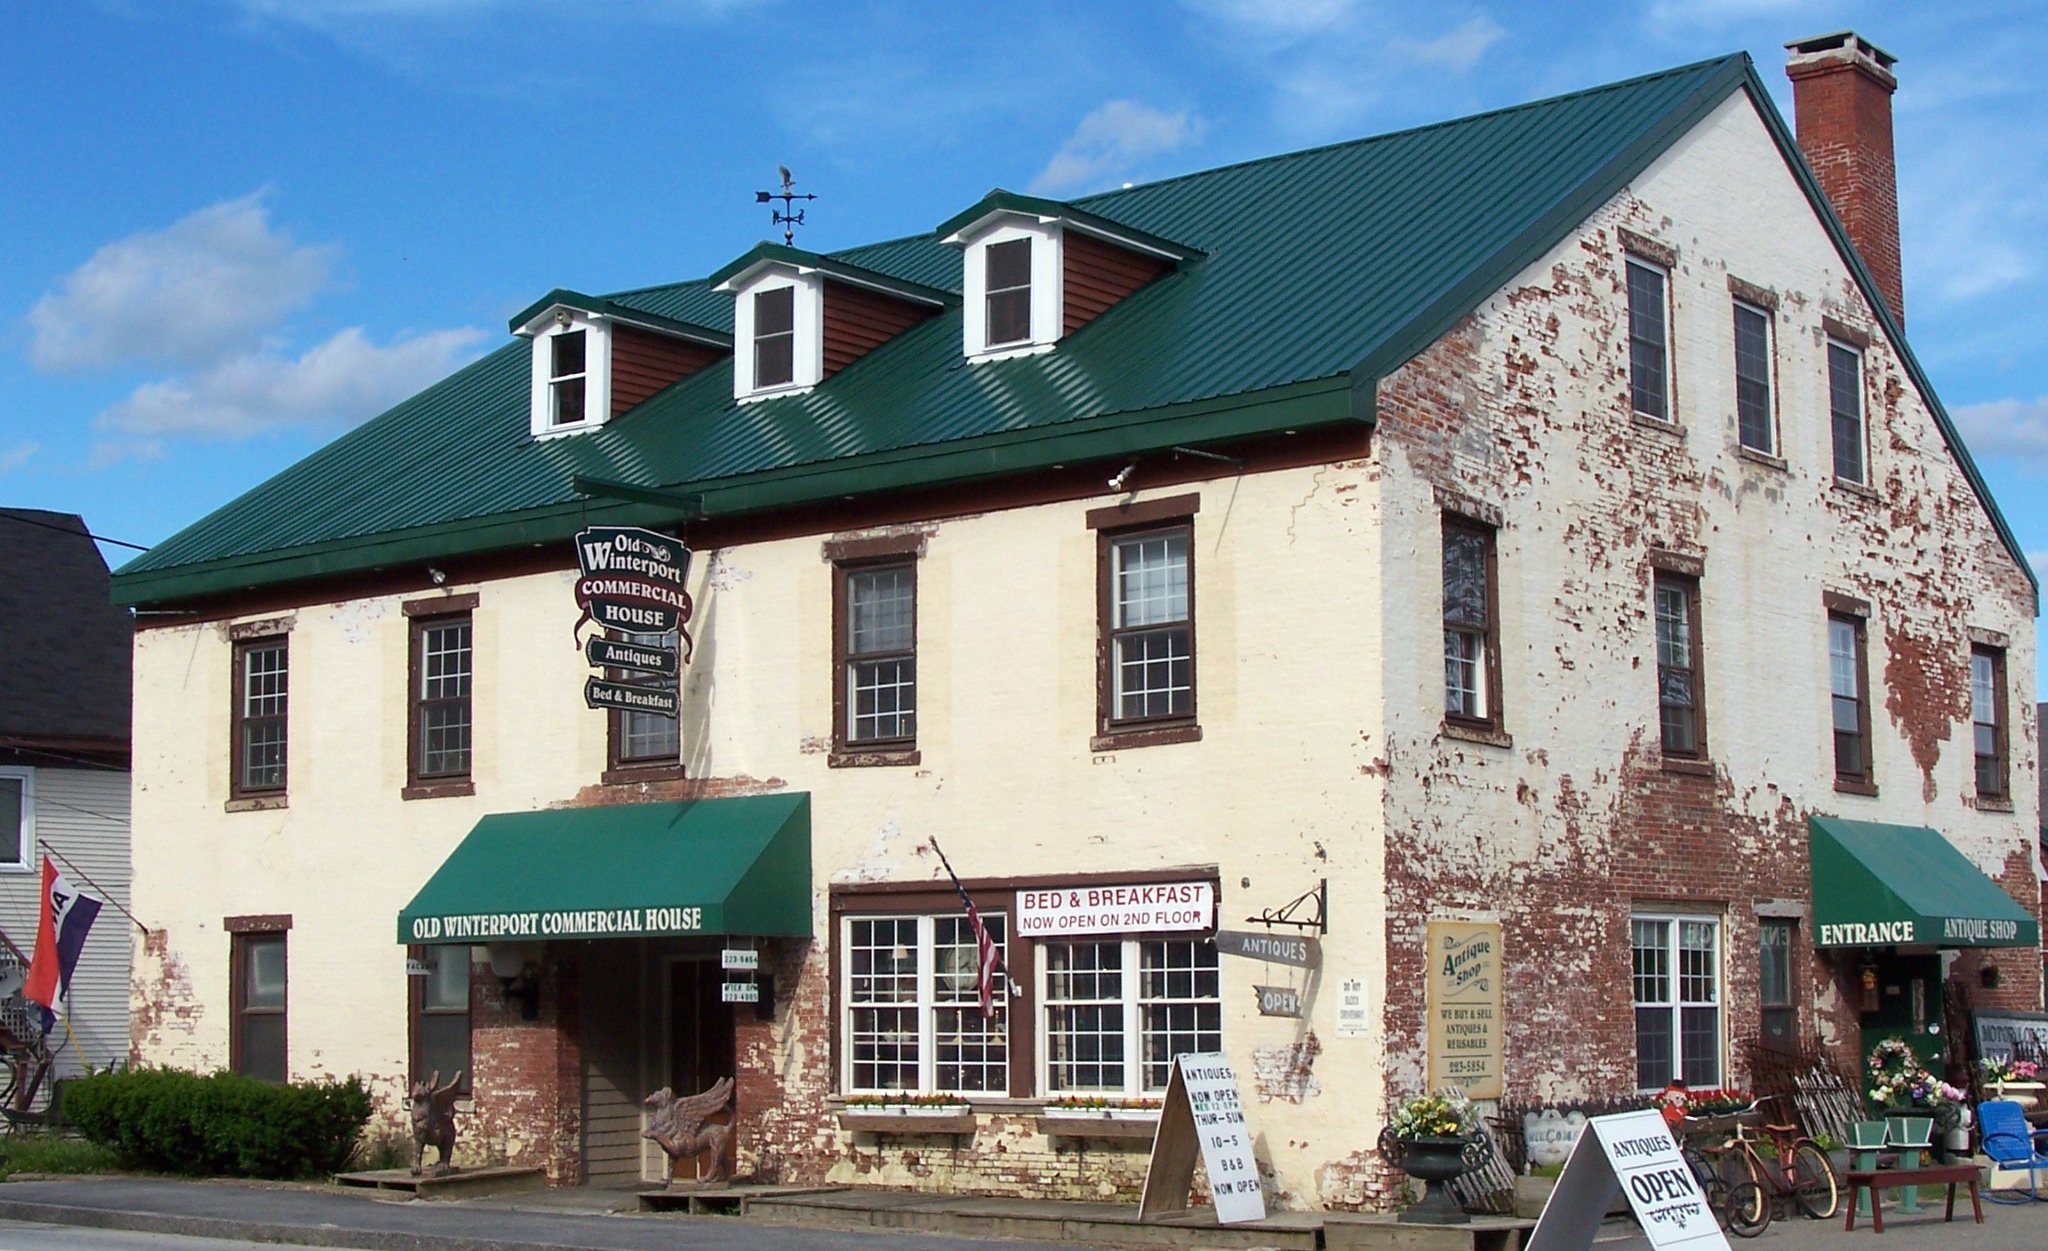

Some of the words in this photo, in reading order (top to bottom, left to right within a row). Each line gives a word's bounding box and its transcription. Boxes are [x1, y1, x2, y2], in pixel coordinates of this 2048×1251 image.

[614, 534, 641, 553] Old
[584, 541, 681, 583] Winterport
[582, 580, 687, 610] COMMERCIAL
[605, 604, 664, 626] HOUSE
[605, 646, 662, 667] Antiques
[593, 687, 612, 700] Bed
[614, 689, 623, 702] &
[625, 690, 673, 709] Breakfast
[1024, 891, 1063, 910] BED
[1069, 892, 1081, 908] &
[1089, 885, 1205, 907] BREAKFAST
[413, 917, 441, 939] OLD
[443, 912, 538, 938] WINTERPORT
[541, 909, 643, 934] COMMERCIAL
[649, 906, 702, 931] HOUSE
[1023, 916, 1056, 930] NOW
[1059, 914, 1096, 929] OPEN
[1100, 913, 1121, 928] ON
[1124, 912, 1151, 926] 2ND
[1155, 910, 1201, 925] FLOOR
[1943, 918, 1988, 943] ANTIQUE
[1990, 920, 2017, 940] SHOP
[1820, 920, 1914, 945] ENTRANCE
[1242, 937, 1307, 962] ANTIQUES
[1442, 940, 1491, 976] Antique
[1456, 961, 1482, 986] Shop
[1263, 990, 1296, 1013] OPEN
[1441, 1009, 1452, 1019] WE
[1454, 1009, 1469, 1020] BUY
[1470, 1009, 1476, 1019] &
[1477, 1009, 1493, 1019] SELL
[1446, 1023, 1481, 1036] ANTIQUES
[1482, 1023, 1488, 1033] &
[1446, 1039, 1487, 1049] REUSABLES
[1185, 1067, 1233, 1081] ANTIQUES
[1449, 1060, 1485, 1073] 223-5854
[1191, 1091, 1211, 1103] NOW
[1214, 1088, 1239, 1101] OPEN
[1210, 1134, 1239, 1149] 10-5
[1612, 1135, 1672, 1158] ANTIQUES
[1221, 1157, 1244, 1172] B&B
[1213, 1182, 1233, 1196] NOW
[1237, 1179, 1260, 1193] OPEN
[1630, 1167, 1695, 1206] OPEN
